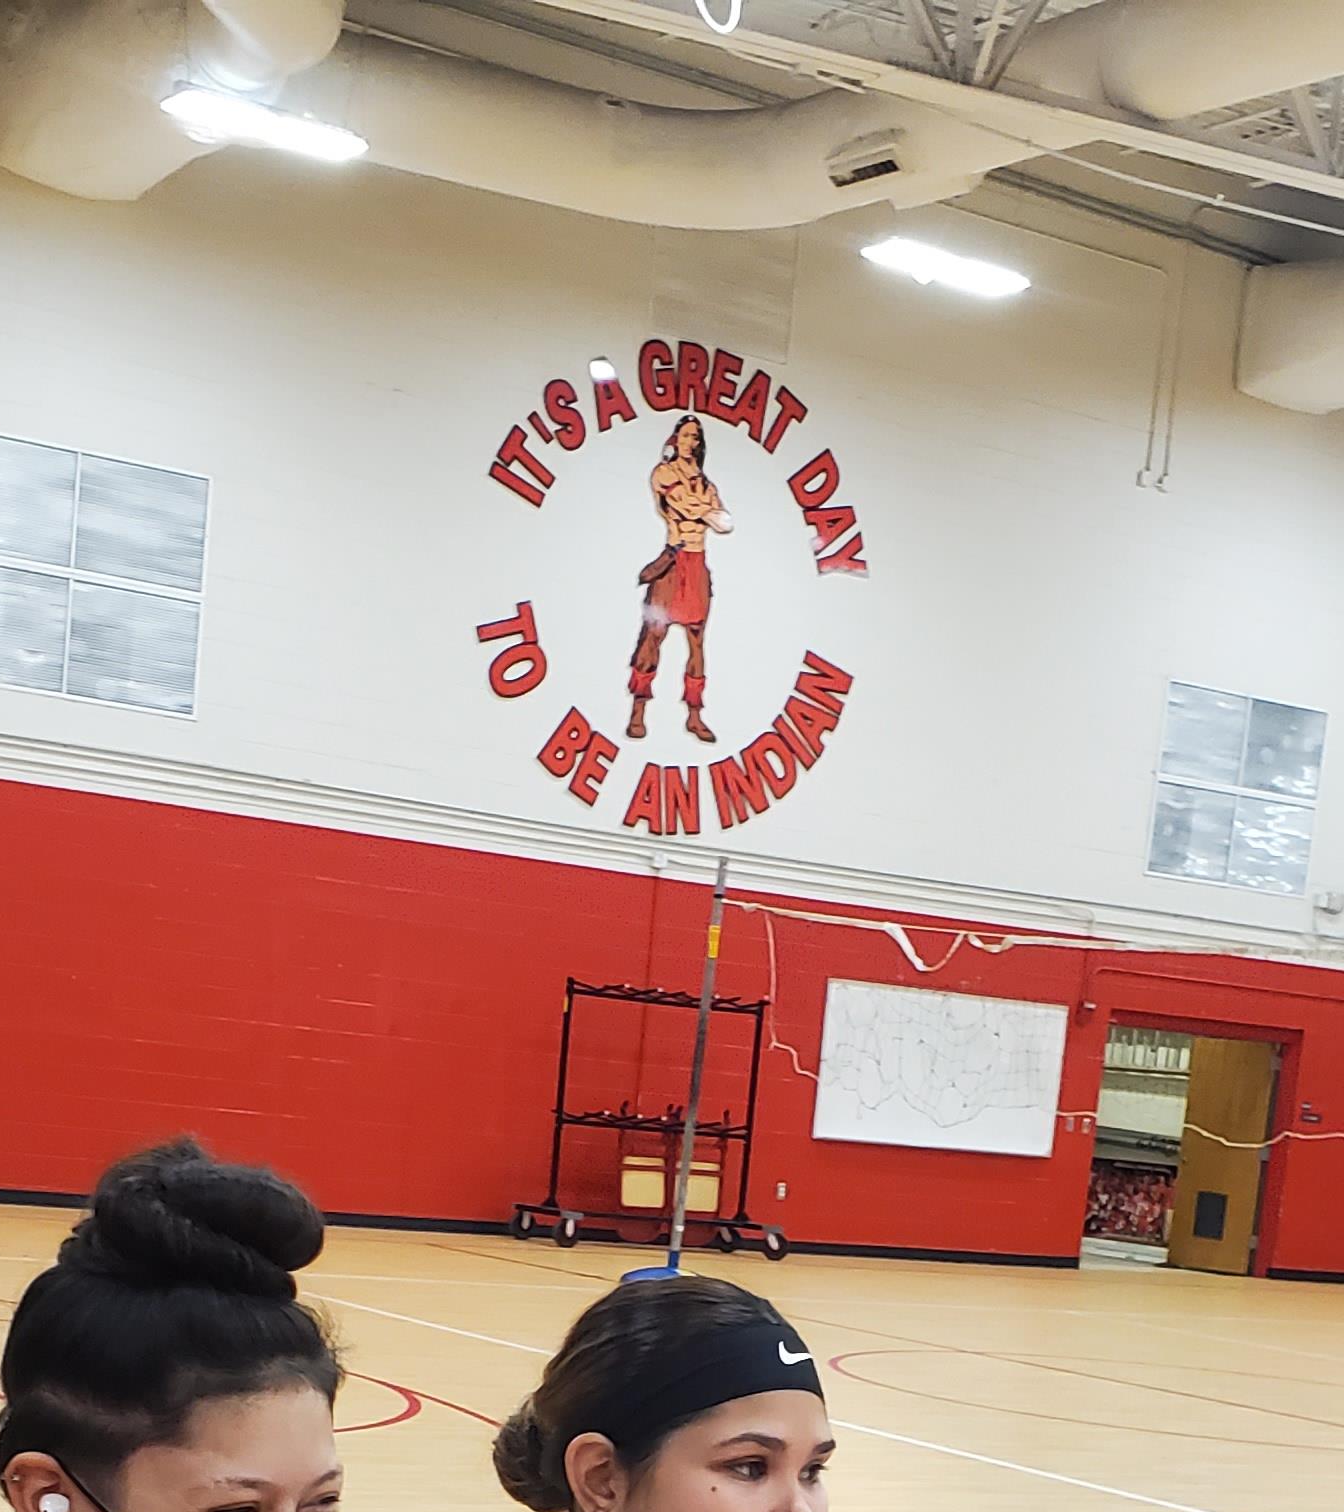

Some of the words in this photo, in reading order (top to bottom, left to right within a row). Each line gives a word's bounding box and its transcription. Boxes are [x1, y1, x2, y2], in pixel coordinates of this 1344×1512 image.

[488, 378, 587, 508] IT'S
[588, 357, 638, 432] A
[638, 338, 809, 455] GREAT
[787, 448, 870, 579] DAY
[476, 600, 548, 699] TO
[537, 705, 620, 807] BE
[623, 762, 702, 836] AN
[709, 650, 855, 830] INDIAN
